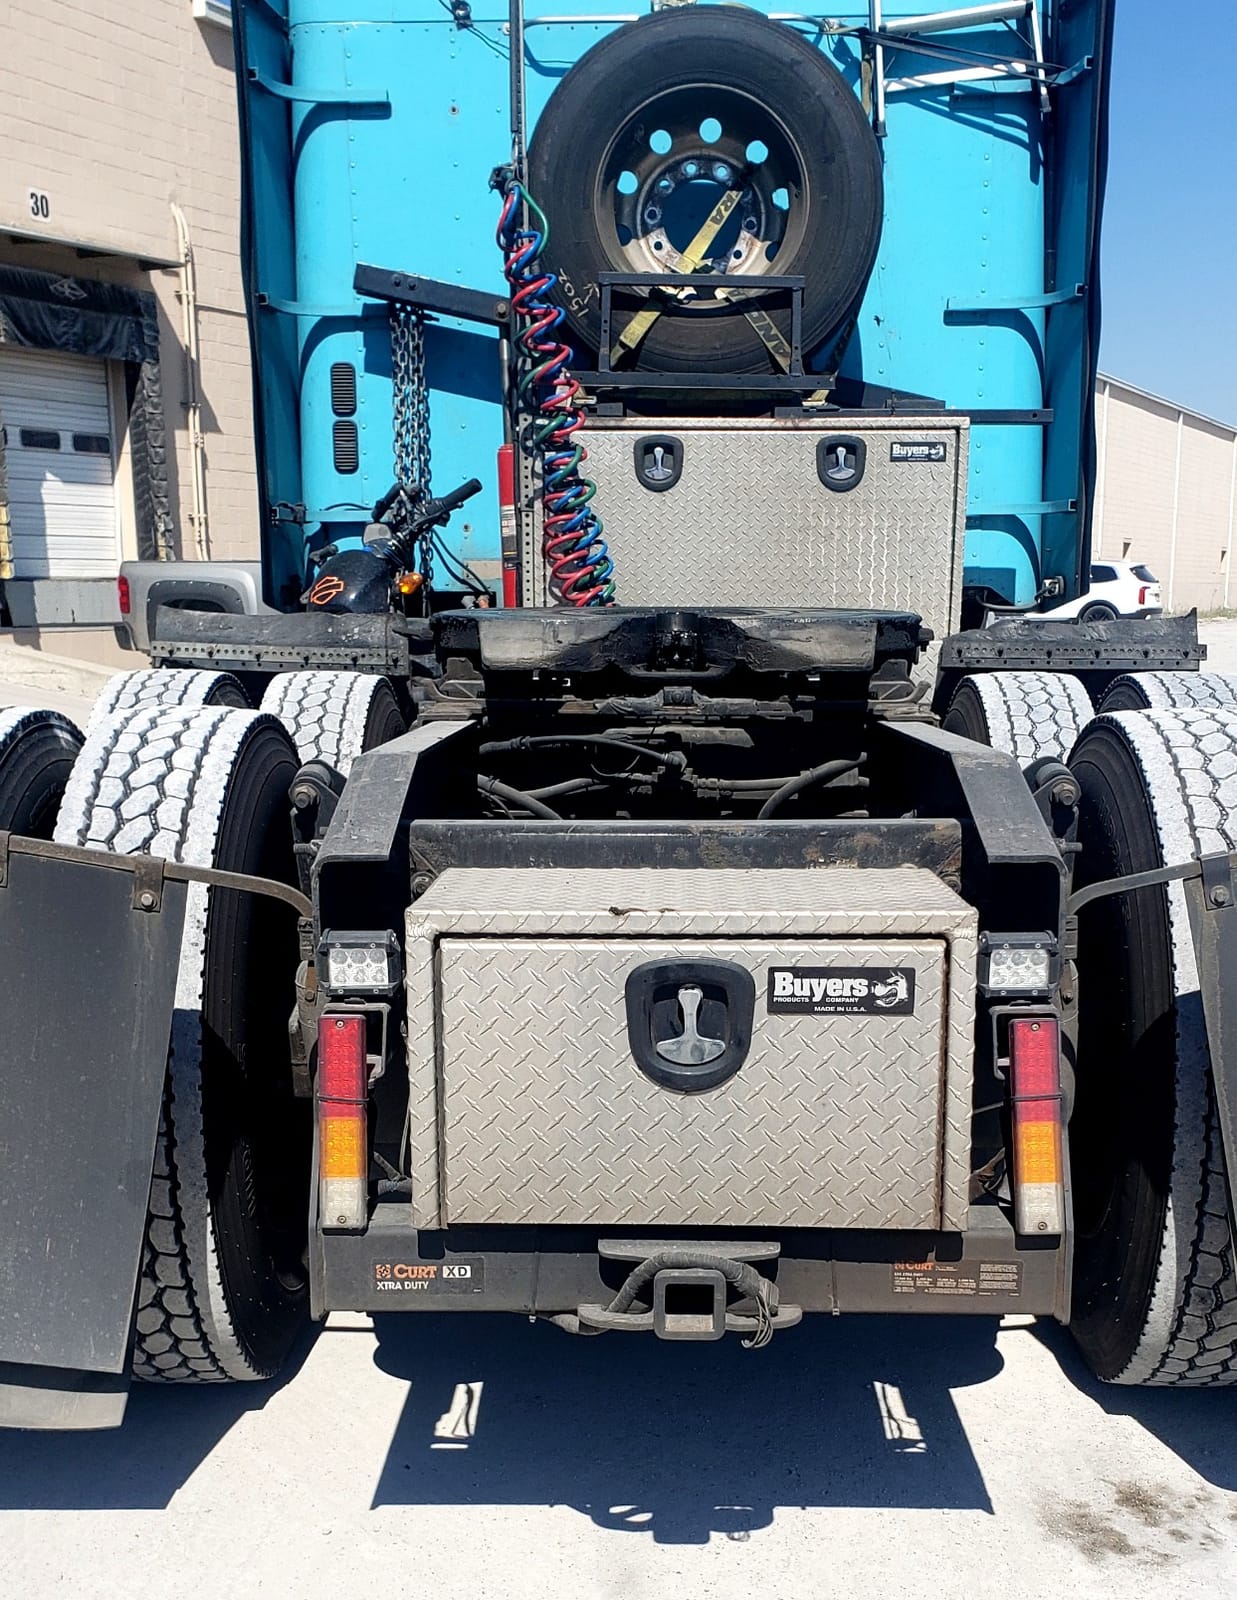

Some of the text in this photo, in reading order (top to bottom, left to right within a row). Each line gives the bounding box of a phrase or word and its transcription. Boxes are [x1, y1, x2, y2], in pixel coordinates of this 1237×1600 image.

[30, 192, 49, 218] 30
[710, 191, 741, 226] RA
[773, 972, 868, 1002] Buyers
[393, 1264, 469, 1279] CURT XD
[376, 1281, 429, 1290] XTRA DUTY
